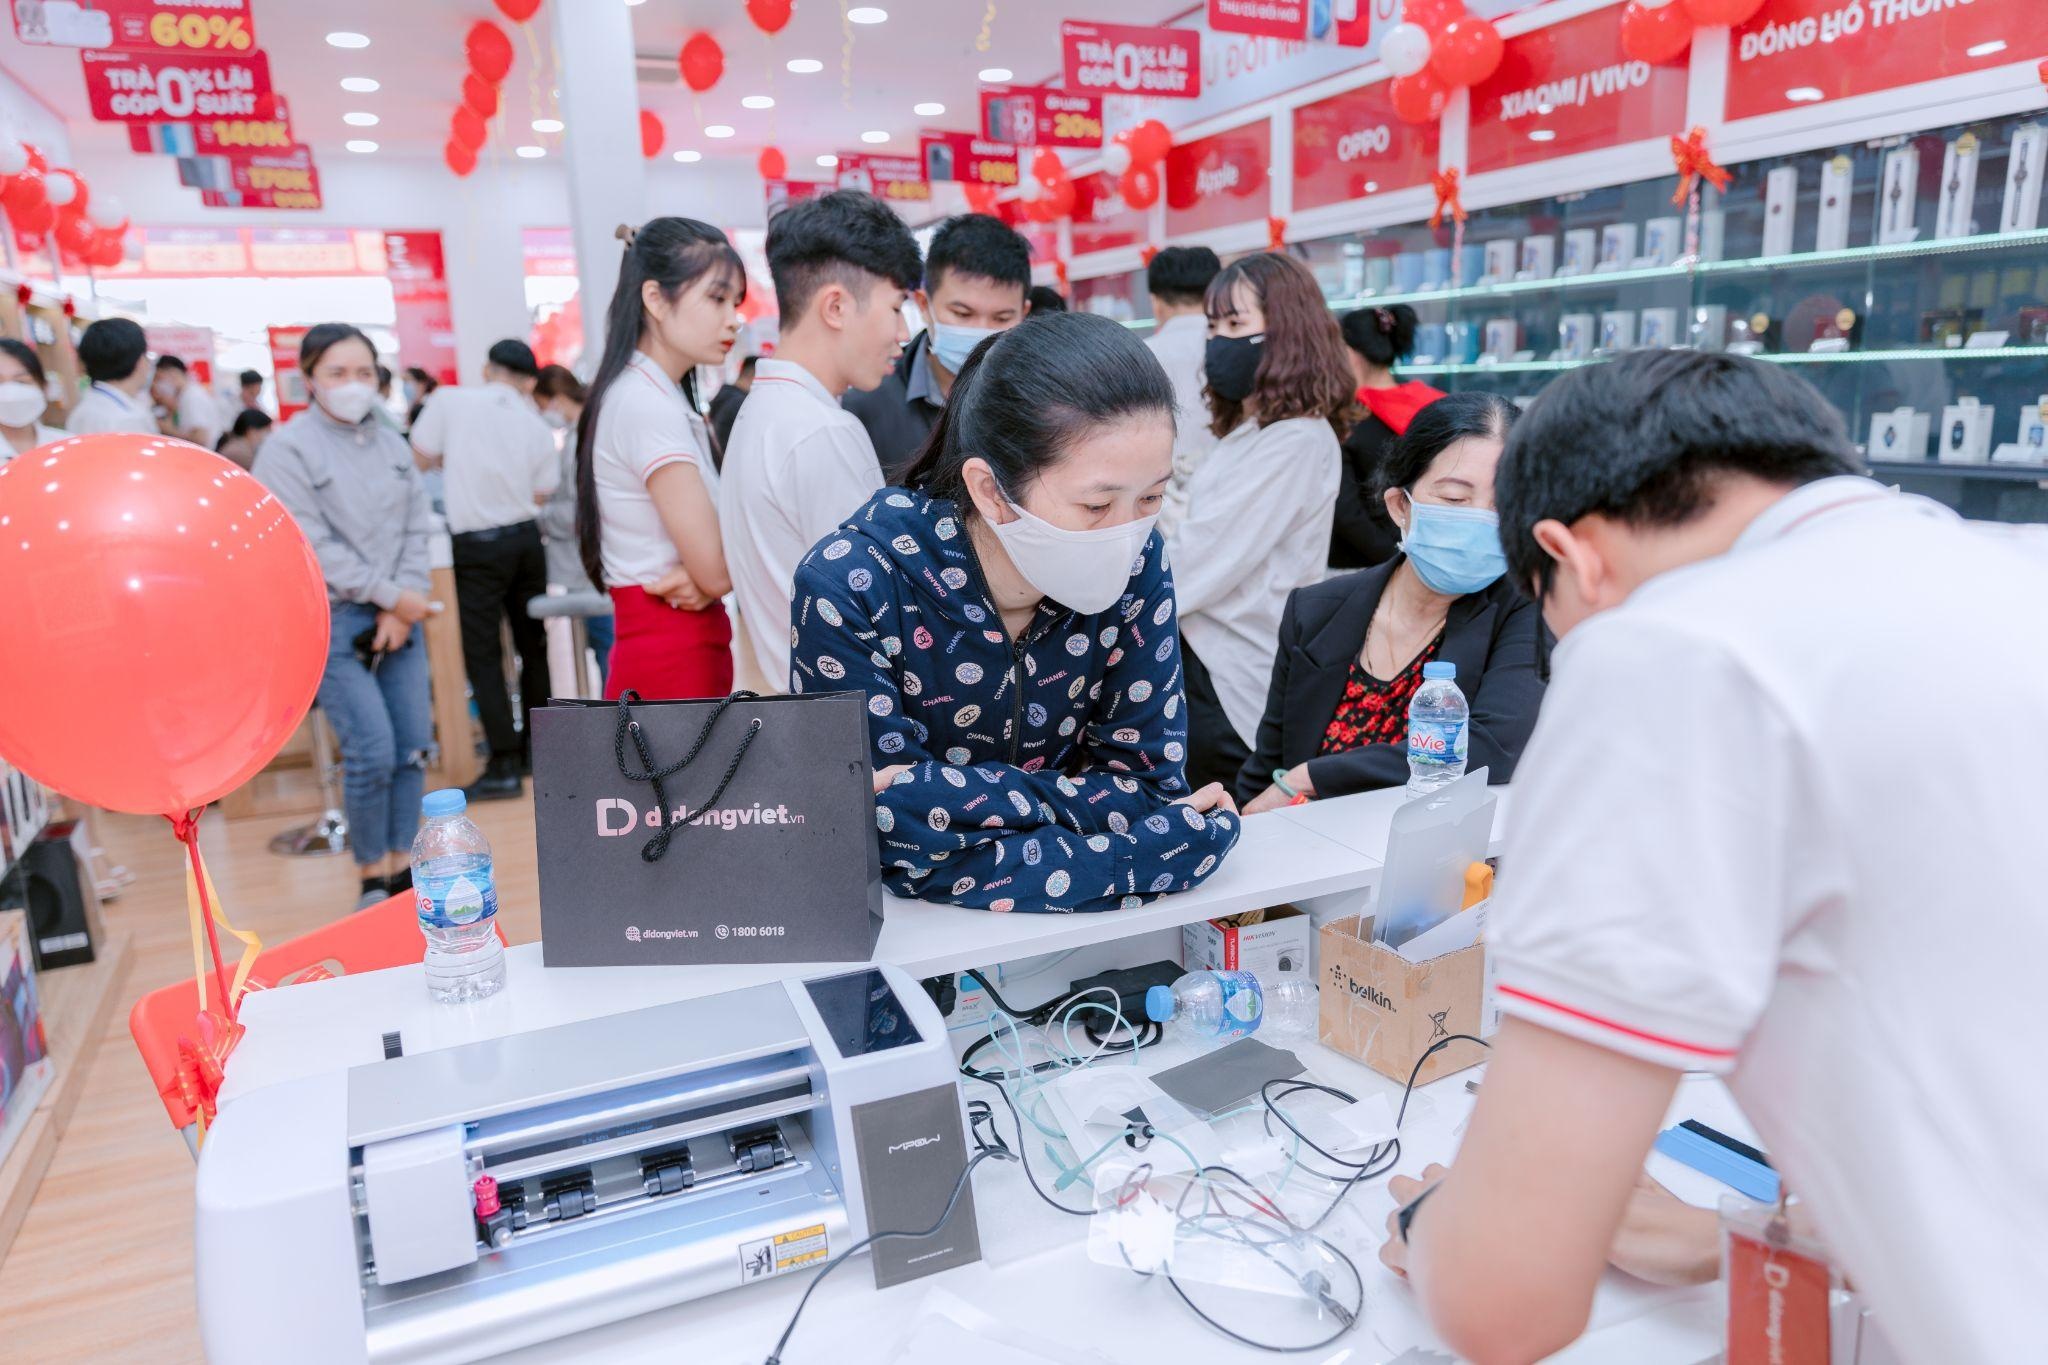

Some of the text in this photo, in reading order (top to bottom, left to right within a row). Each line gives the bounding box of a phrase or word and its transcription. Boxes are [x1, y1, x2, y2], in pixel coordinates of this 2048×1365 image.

[150, 12, 250, 50] 60%
[1500, 76, 1577, 121] XIAOMI
[1590, 60, 1651, 97] VIVO
[1337, 125, 1390, 162] OPPO
[867, 545, 893, 575] CHANEL
[922, 566, 948, 598] CHANEL
[800, 595, 812, 626] CHANEL
[946, 630, 966, 654] CHANEL
[1037, 669, 1069, 687] CHANEL
[1162, 663, 1180, 693] CHANEL
[922, 695, 955, 707] CHANEL
[1107, 690, 1122, 720] CHANEL
[966, 732, 995, 745] CHANEL
[963, 793, 989, 812] CHANEL
[1088, 788, 1111, 805] CHANEL
[885, 839, 920, 851] CHANEL
[1160, 842, 1189, 861] CHANEL
[642, 927, 699, 940] didongviet.vn
[731, 926, 785, 937] 1800 6018
[1349, 977, 1392, 1011] belkin
